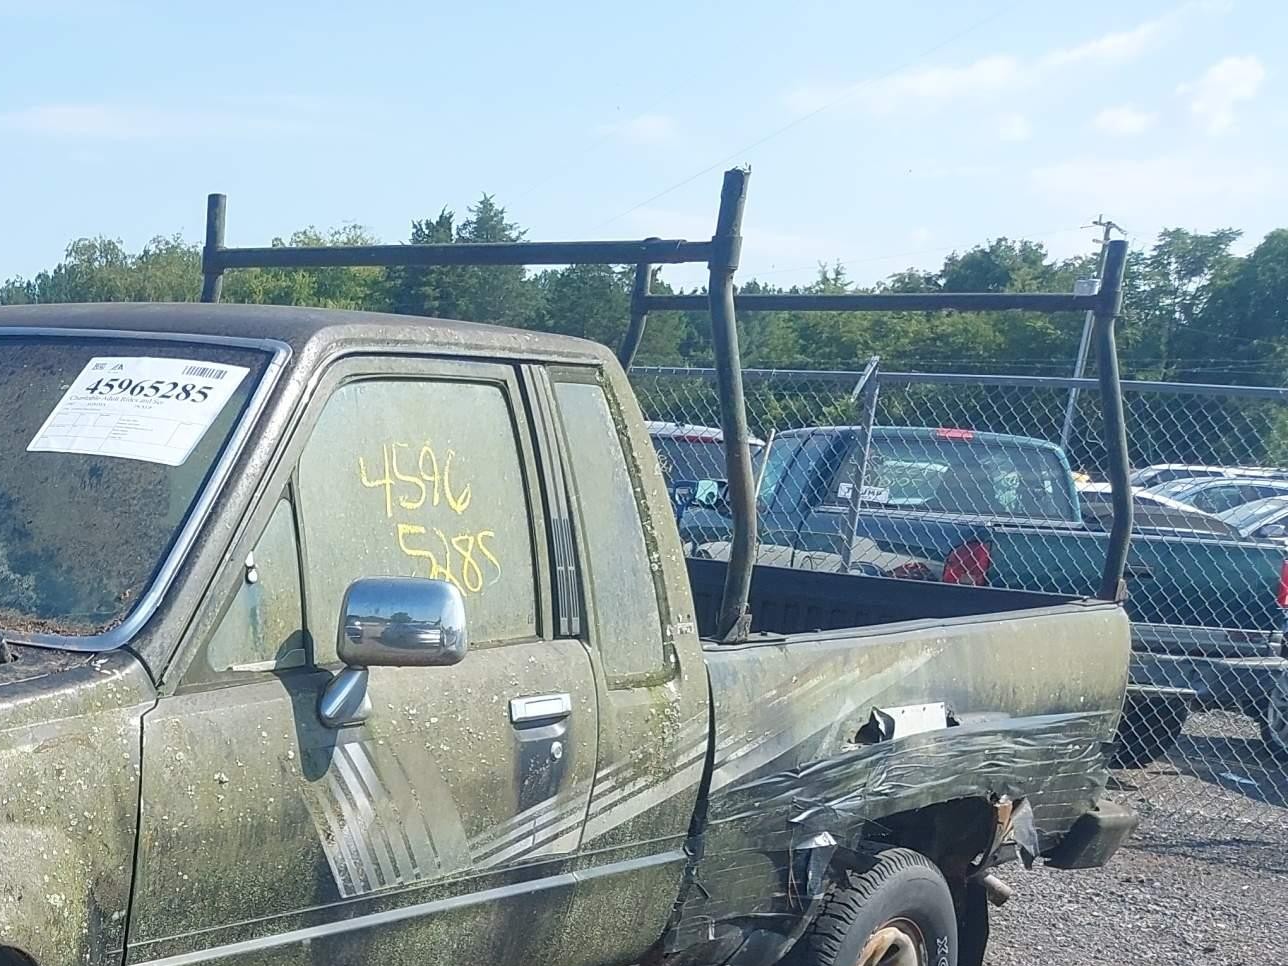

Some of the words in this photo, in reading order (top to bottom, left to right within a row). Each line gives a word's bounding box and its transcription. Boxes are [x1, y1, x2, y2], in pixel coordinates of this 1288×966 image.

[86, 378, 213, 403] 45965285
[359, 440, 472, 517] 4596
[397, 523, 502, 597] 5285
